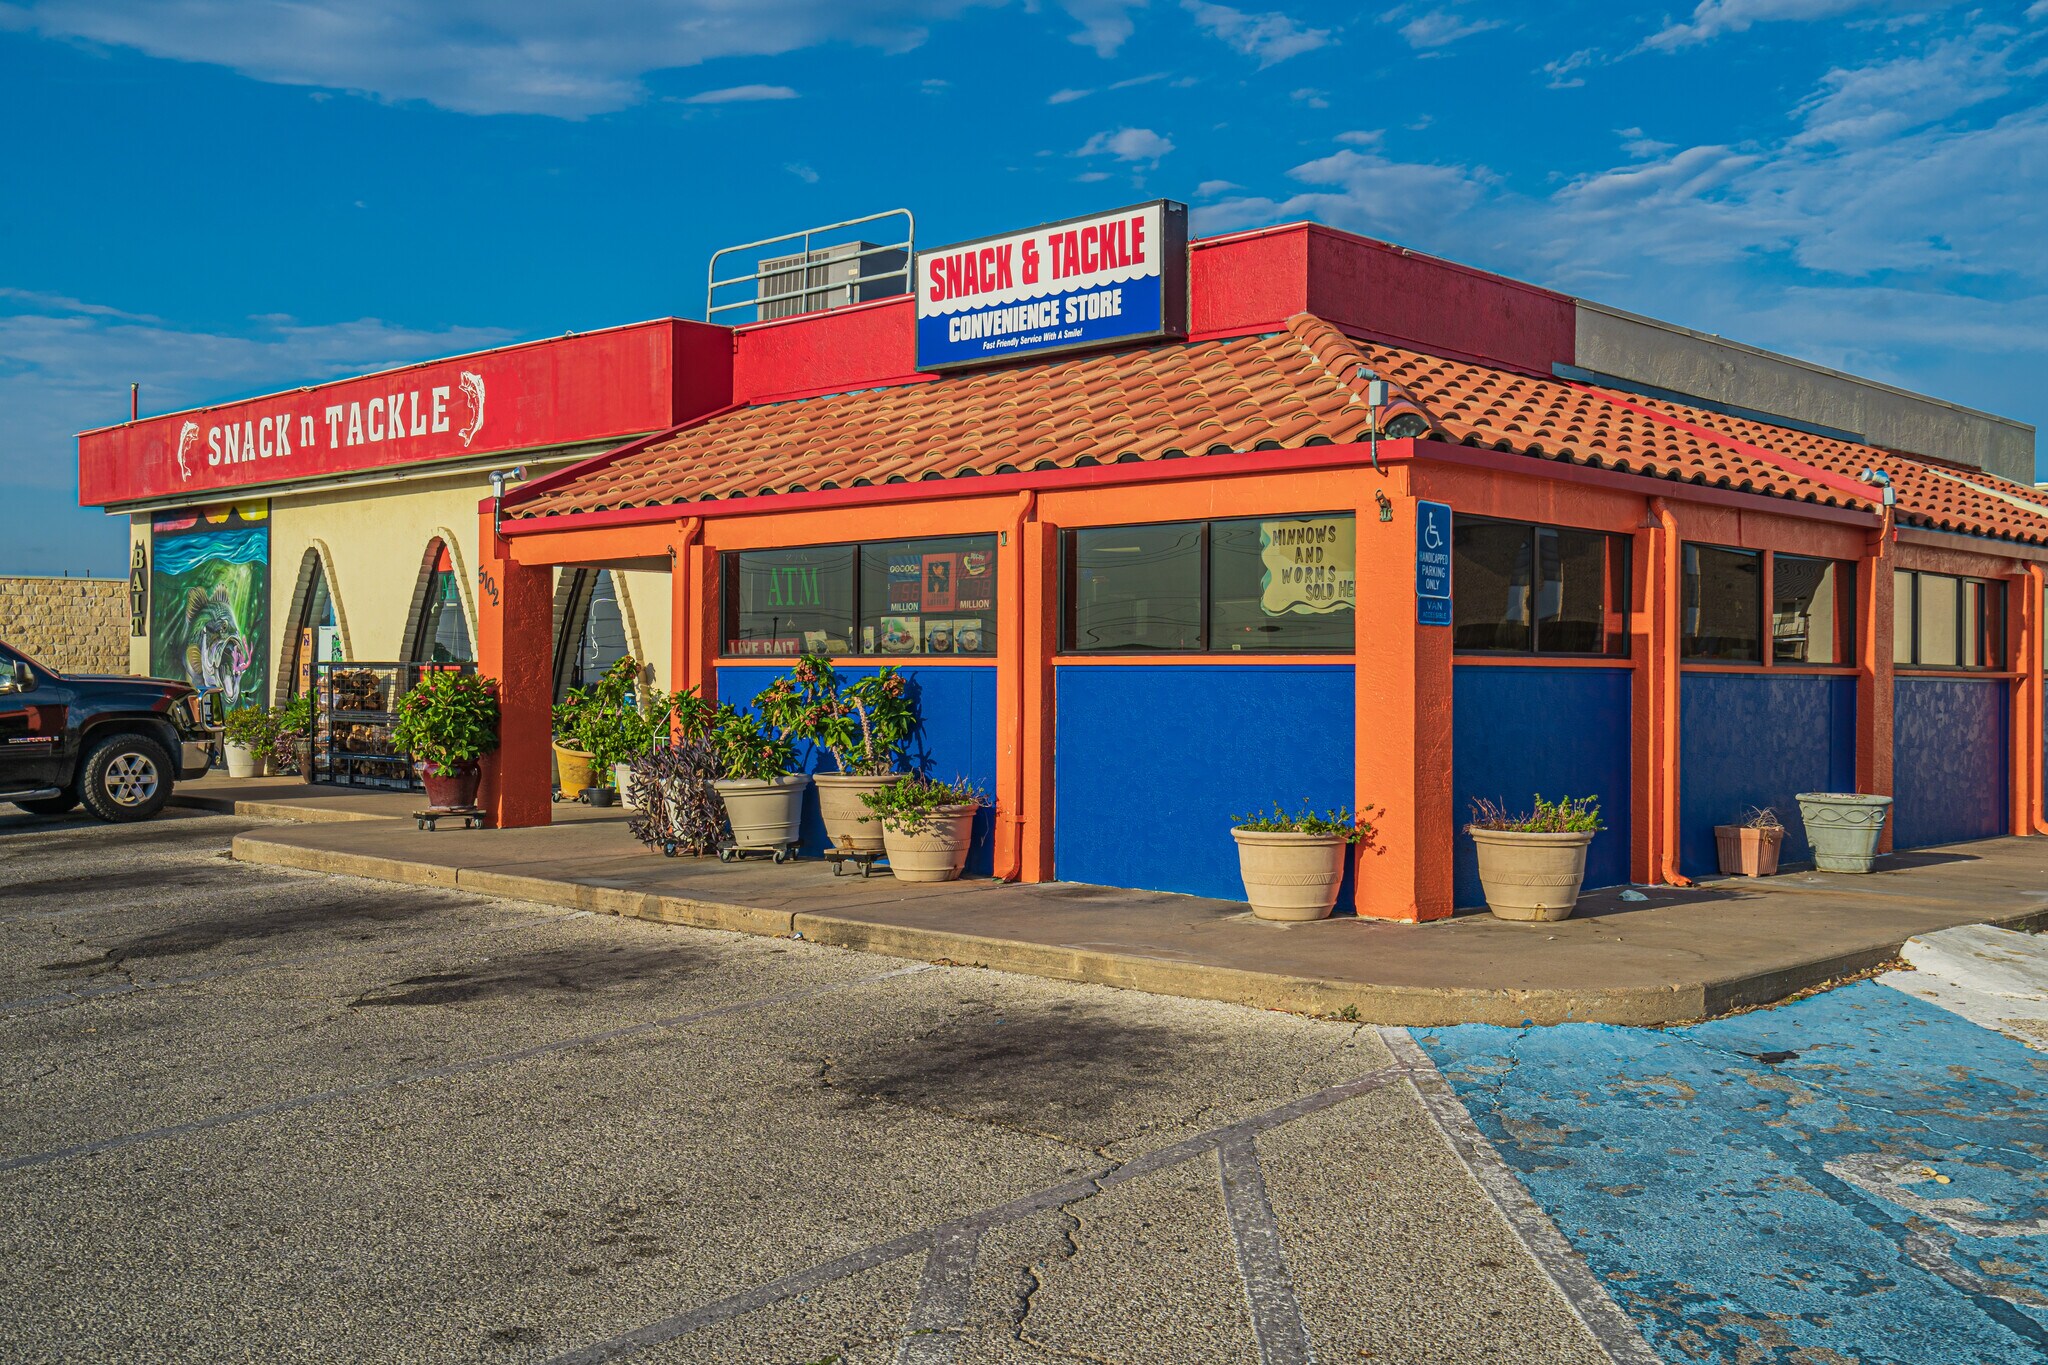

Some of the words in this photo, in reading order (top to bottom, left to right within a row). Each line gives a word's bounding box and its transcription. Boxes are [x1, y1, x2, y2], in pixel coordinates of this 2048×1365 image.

[930, 243, 1013, 302] SNACK
[1021, 238, 1040, 285] &
[1048, 215, 1145, 280] TACKLE
[949, 300, 1060, 343] CONVENIENCE
[1065, 288, 1122, 323] STORE
[982, 341, 995, 350] Fast
[996, 337, 1019, 347] Friendly
[1020, 334, 1042, 344] Service
[1043, 331, 1057, 341] With
[1057, 330, 1063, 339] A
[1064, 327, 1083, 338] Smile!
[208, 413, 291, 466] SNACK
[300, 414, 315, 447] n
[325, 386, 450, 449] TACKLE
[1272, 525, 1336, 546] MINNOWS
[1295, 546, 1324, 564] AND
[1419, 551, 1448, 565] HANDICAPPED
[1281, 565, 1336, 584] WORMS
[1422, 565, 1446, 578] PARKING
[131, 548, 145, 636] BAIT
[478, 564, 499, 607] 5102
[767, 567, 820, 606] ATM
[1305, 583, 1334, 601] SOLD
[1425, 578, 1440, 590] ONLY
[891, 602, 919, 612] MILLION
[960, 600, 990, 608] MILLION
[1427, 601, 1442, 610] VAN
[1422, 610, 1447, 619] ACCESSIBLE
[764, 641, 795, 654] BAIT
